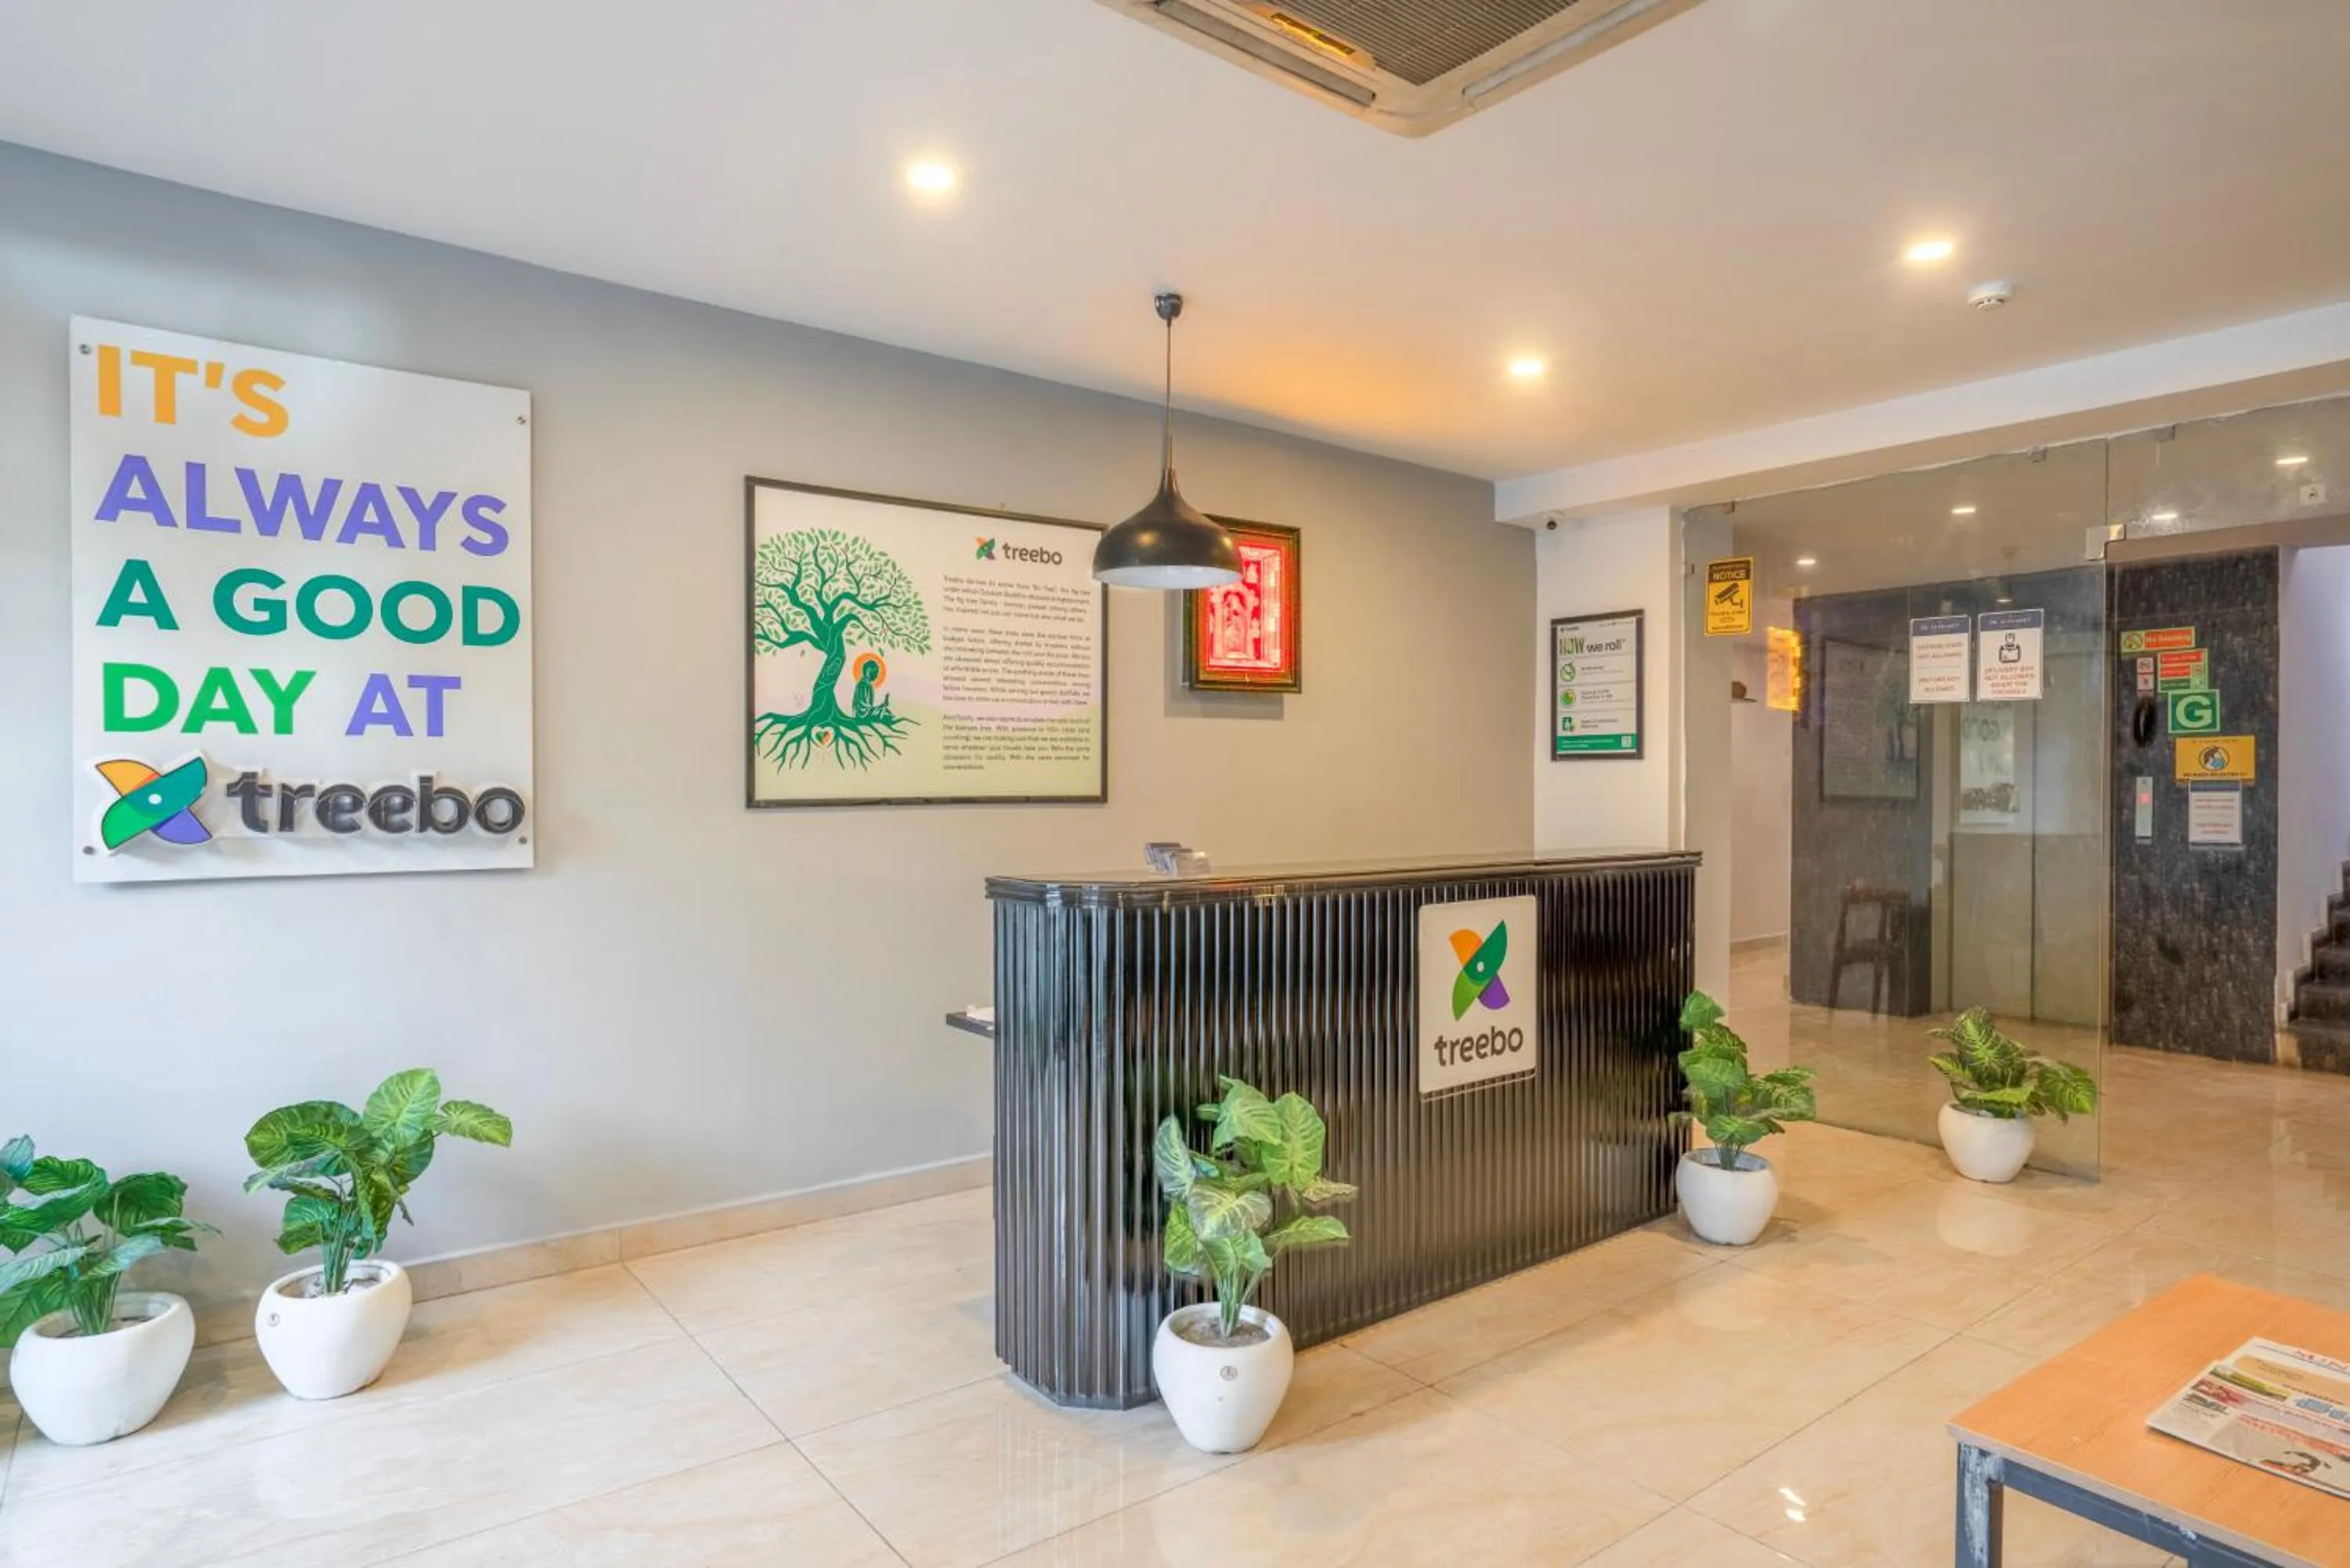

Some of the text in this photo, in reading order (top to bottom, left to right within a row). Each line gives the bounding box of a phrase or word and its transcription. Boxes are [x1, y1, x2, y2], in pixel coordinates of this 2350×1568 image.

[97, 344, 290, 437] IT'S
[94, 453, 509, 557] ALWAYS
[1002, 542, 1063, 565] treebo
[1713, 569, 1746, 580] NOTICE
[96, 559, 521, 646] A GOOD
[1587, 642, 1603, 652] we
[102, 663, 461, 737] DAY AT
[2175, 695, 2213, 729] G
[226, 771, 526, 836] treebo
[1434, 1024, 1524, 1067] treebo
